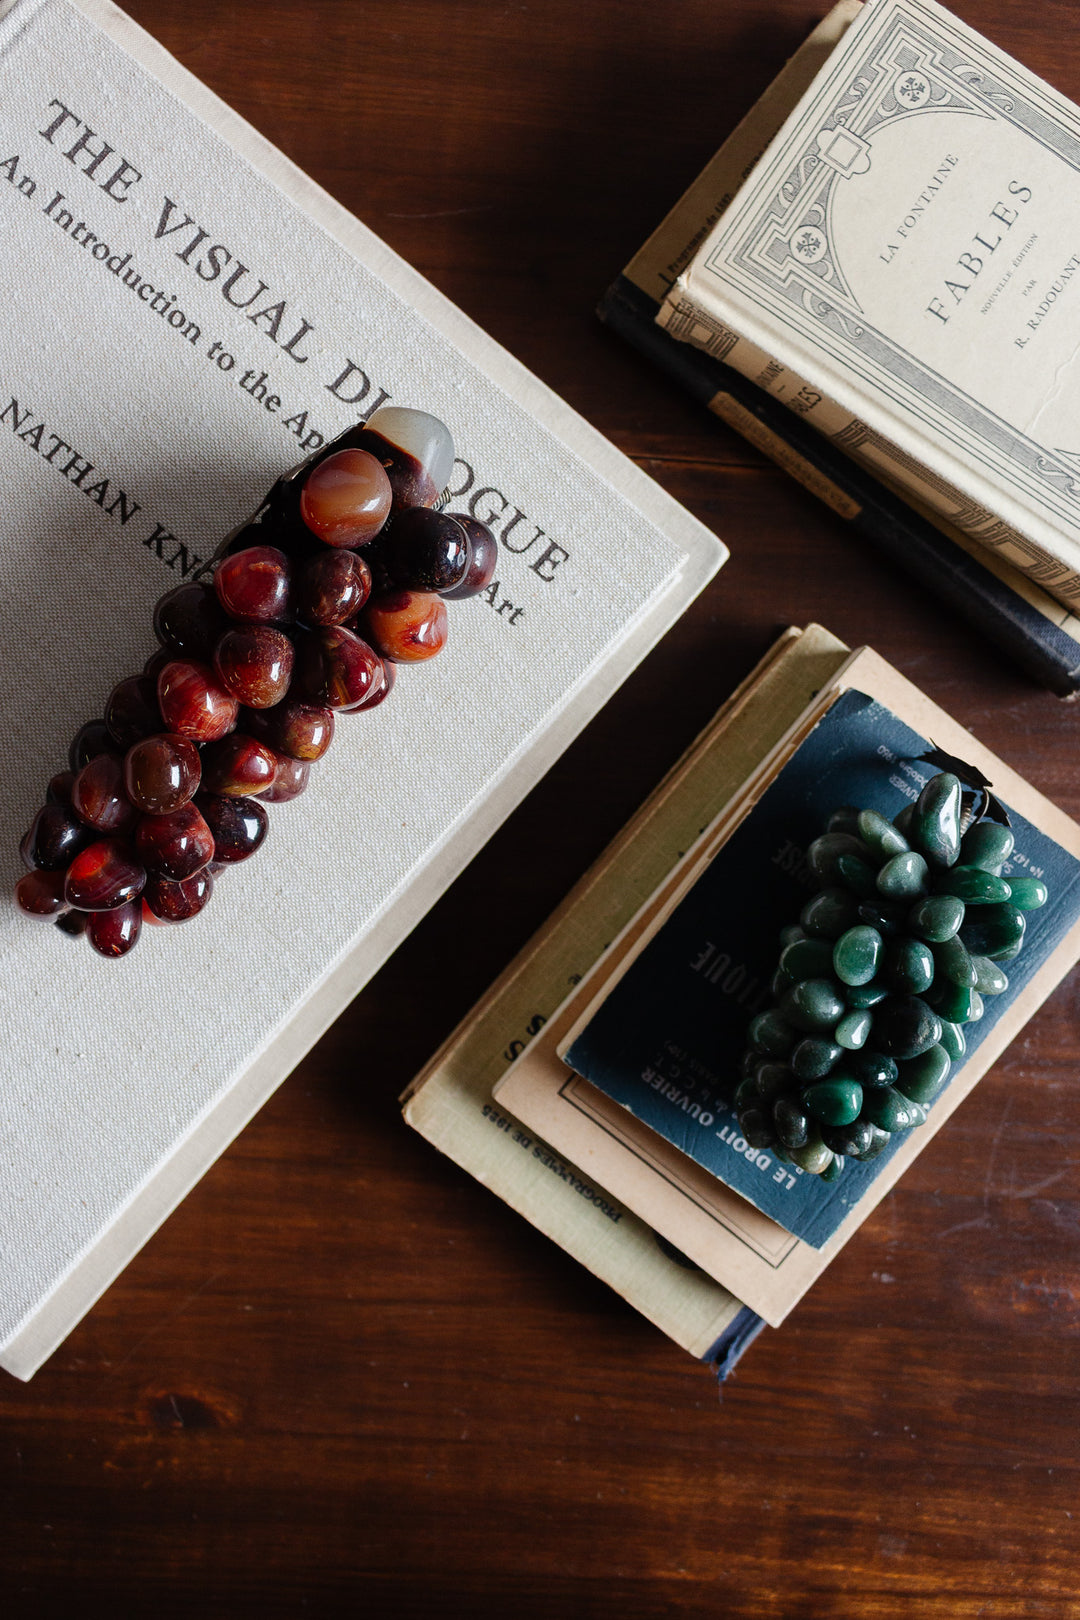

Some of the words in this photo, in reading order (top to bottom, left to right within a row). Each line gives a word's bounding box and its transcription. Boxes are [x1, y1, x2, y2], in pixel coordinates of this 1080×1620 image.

[39, 98, 143, 204] THE
[154, 195, 314, 364] VISUAL
[879, 243, 900, 265] LA
[896, 154, 960, 239] FONTAINE
[925, 180, 1033, 326] FABLES
[979, 269, 1014, 316] NOUVELLE
[1012, 232, 1039, 268] ÉDITION
[1021, 278, 1038, 298] PAR
[1013, 335, 1031, 350] R.
[1026, 253, 1080, 331] RADOUANT
[0, 155, 37, 200] An
[42, 191, 201, 346] Introduction
[206, 341, 236, 372] to
[238, 369, 282, 413] the
[478, 580, 526, 626] Art
[0, 396, 142, 526] NATHAN
[877, 745, 898, 764] 1960
[640, 1066, 715, 1127] OUVRIER
[511, 1129, 533, 1150] DE
[715, 1124, 773, 1172] DROIT
[772, 1166, 798, 1191] LE
[531, 1146, 624, 1225] PROGRAMMES
